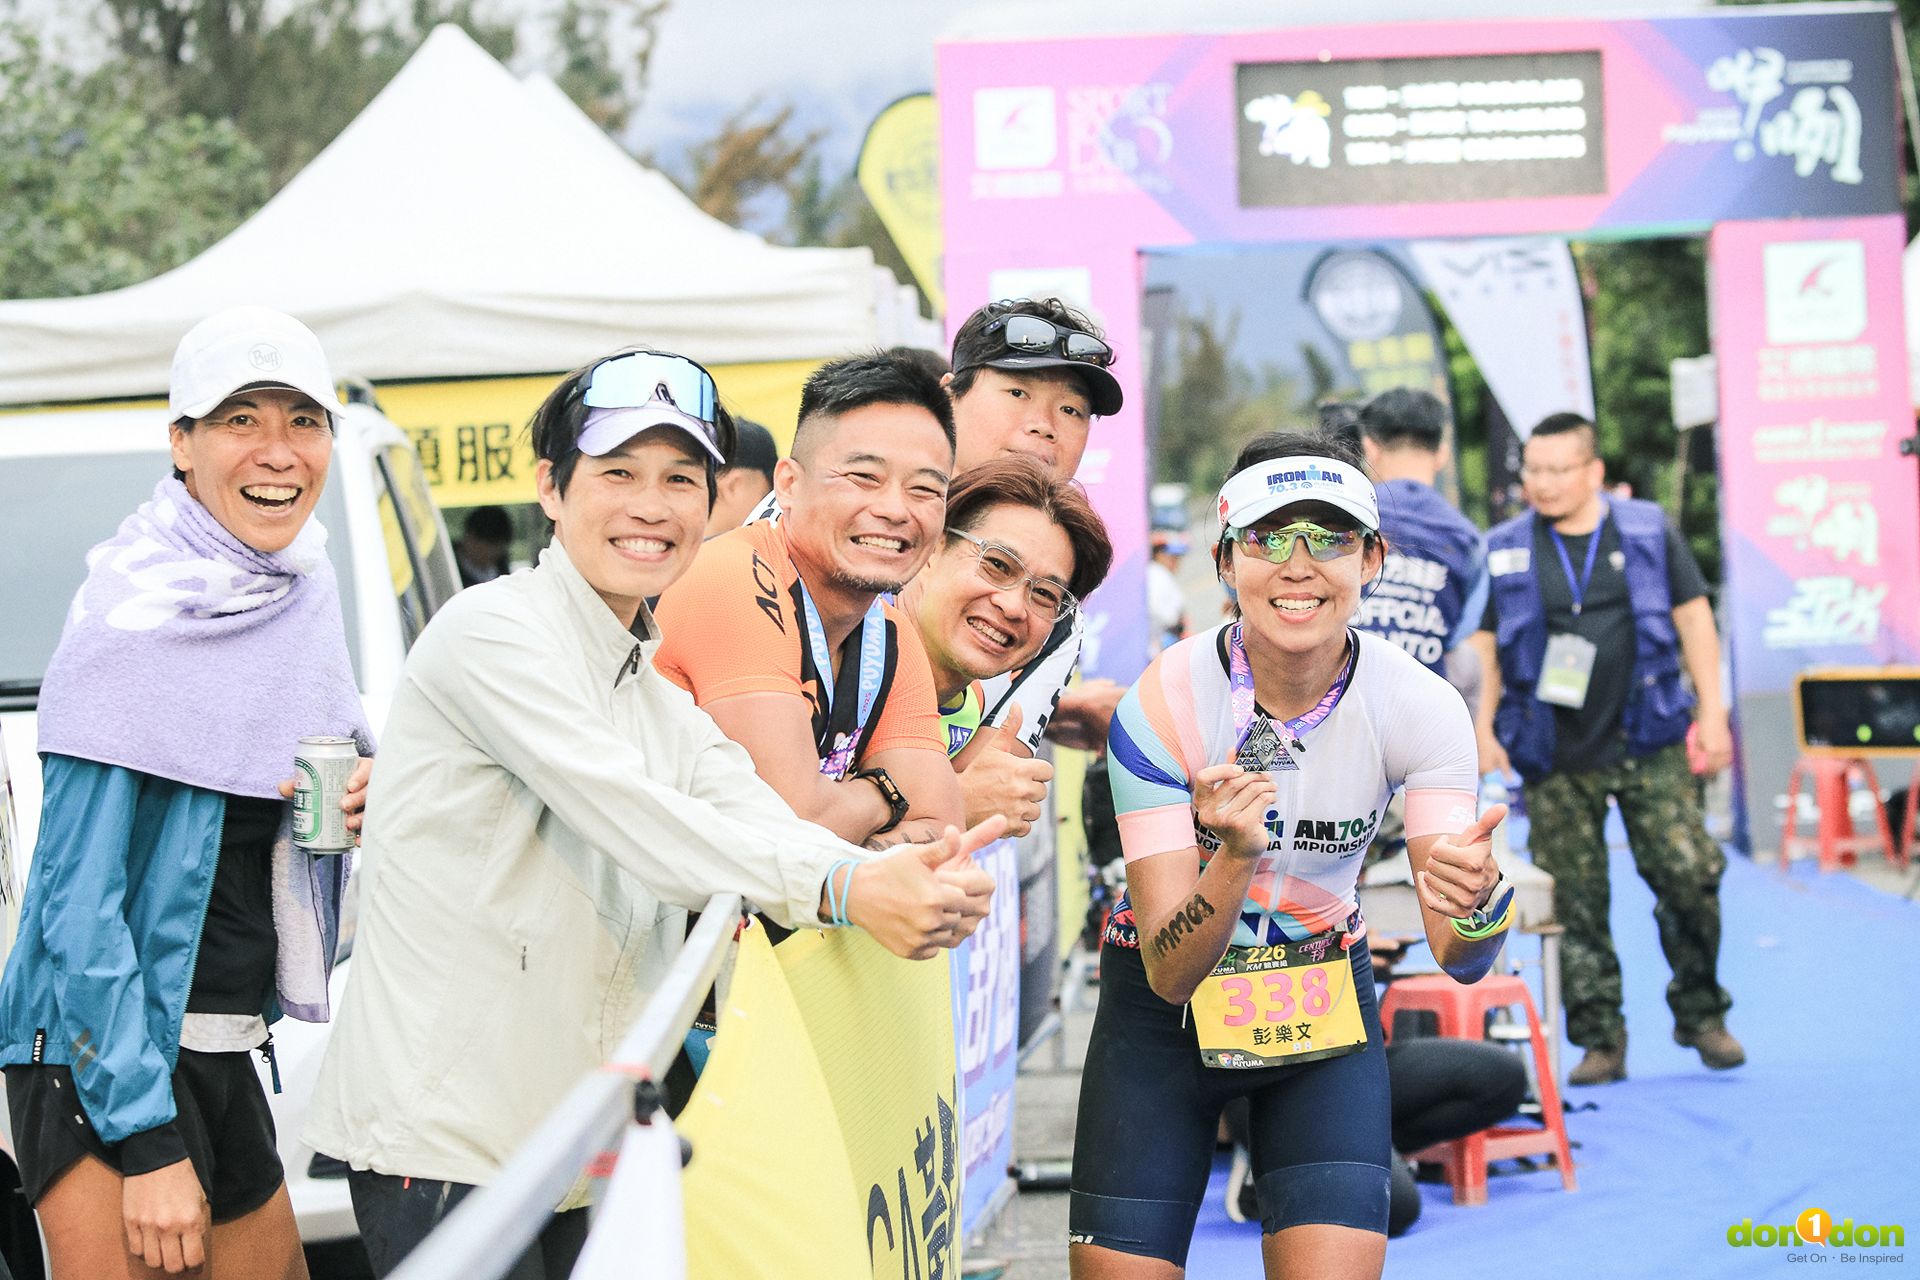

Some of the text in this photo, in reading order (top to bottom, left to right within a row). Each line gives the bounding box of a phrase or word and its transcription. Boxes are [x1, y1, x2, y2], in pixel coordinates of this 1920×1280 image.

[1266, 464, 1344, 486] IRONMAN
[1268, 482, 1298, 496] 70.3
[861, 616, 882, 691] PUYUMA
[1246, 944, 1287, 964] 226
[1246, 963, 1264, 972] KM
[1220, 967, 1332, 1027] 338
[1252, 1022, 1313, 1046] 彭樂文
